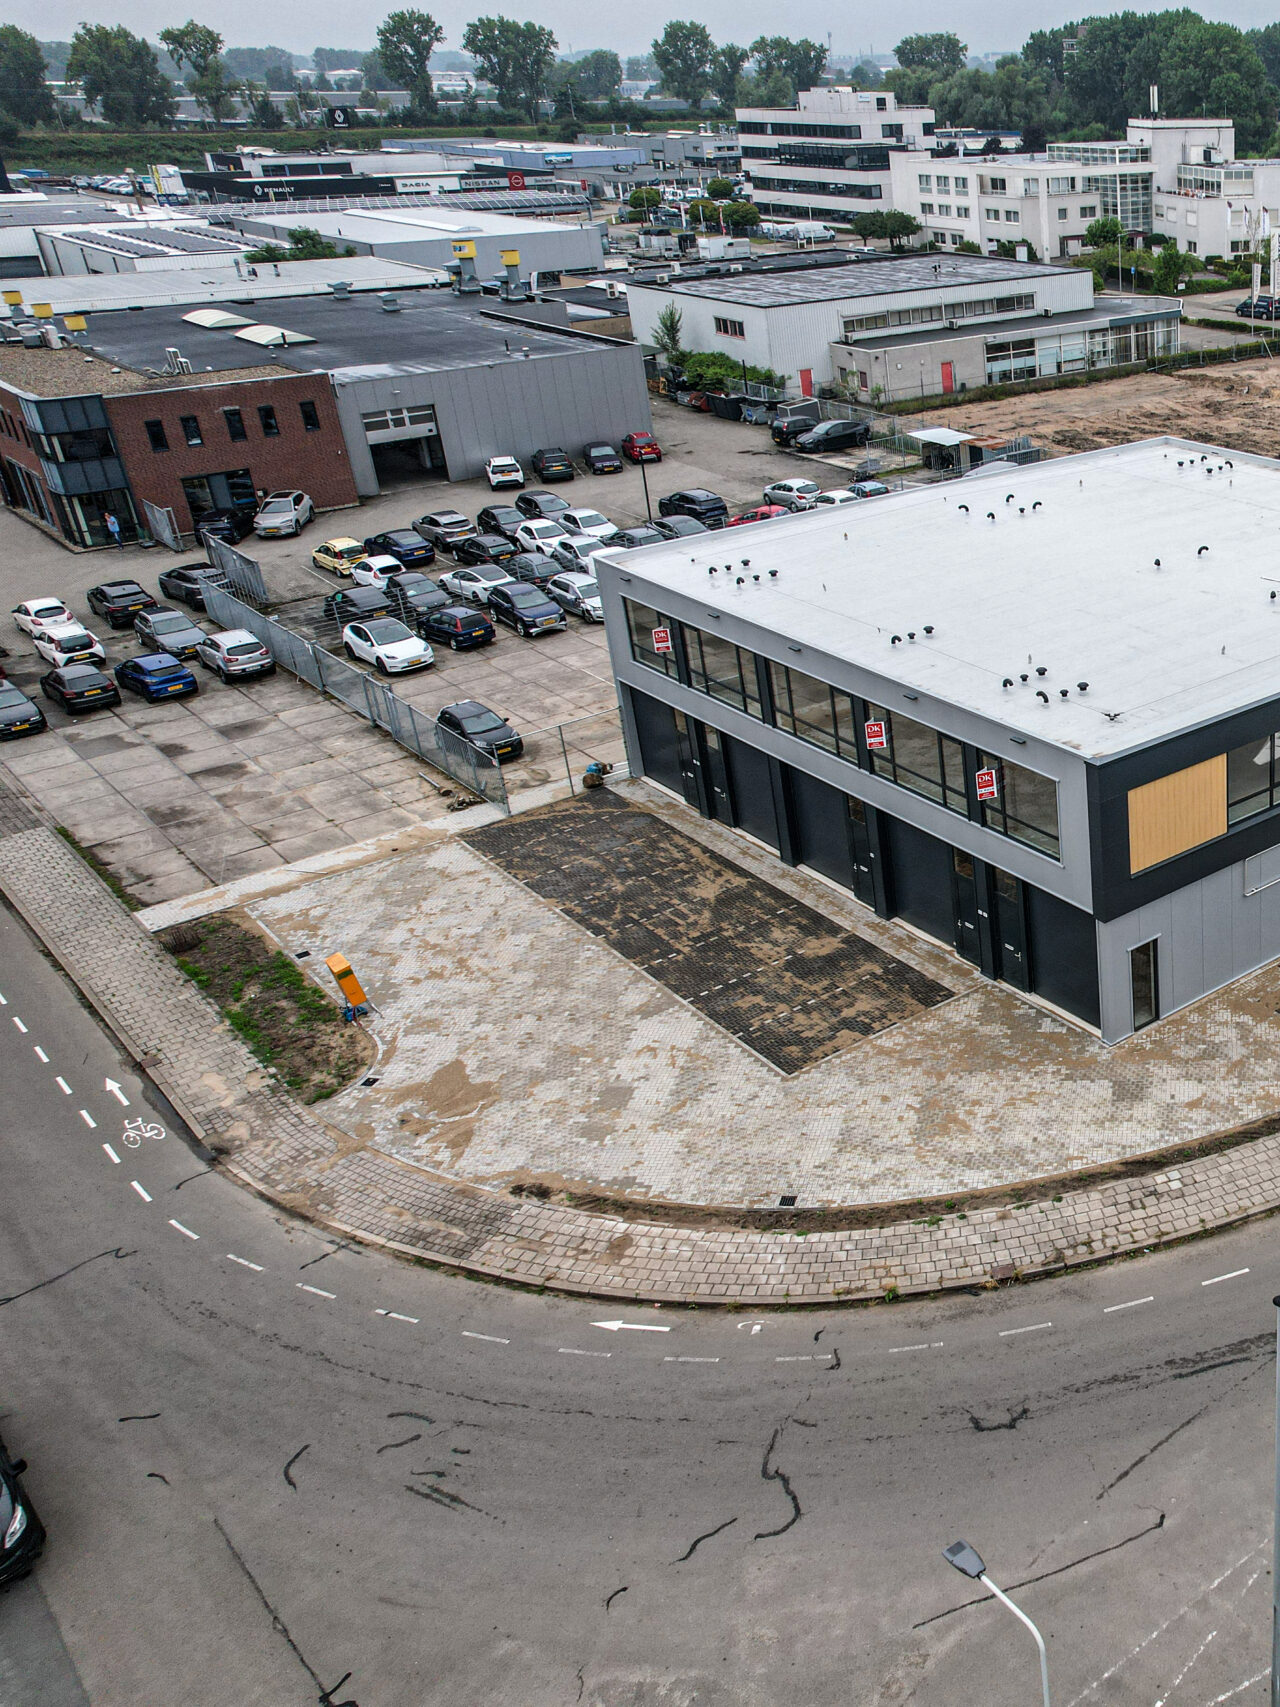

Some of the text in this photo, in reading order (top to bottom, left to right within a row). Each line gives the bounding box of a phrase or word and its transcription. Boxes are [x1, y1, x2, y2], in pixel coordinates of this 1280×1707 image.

[655, 631, 667, 639] DK
[867, 724, 881, 733] DK
[978, 773, 992, 783] DK
